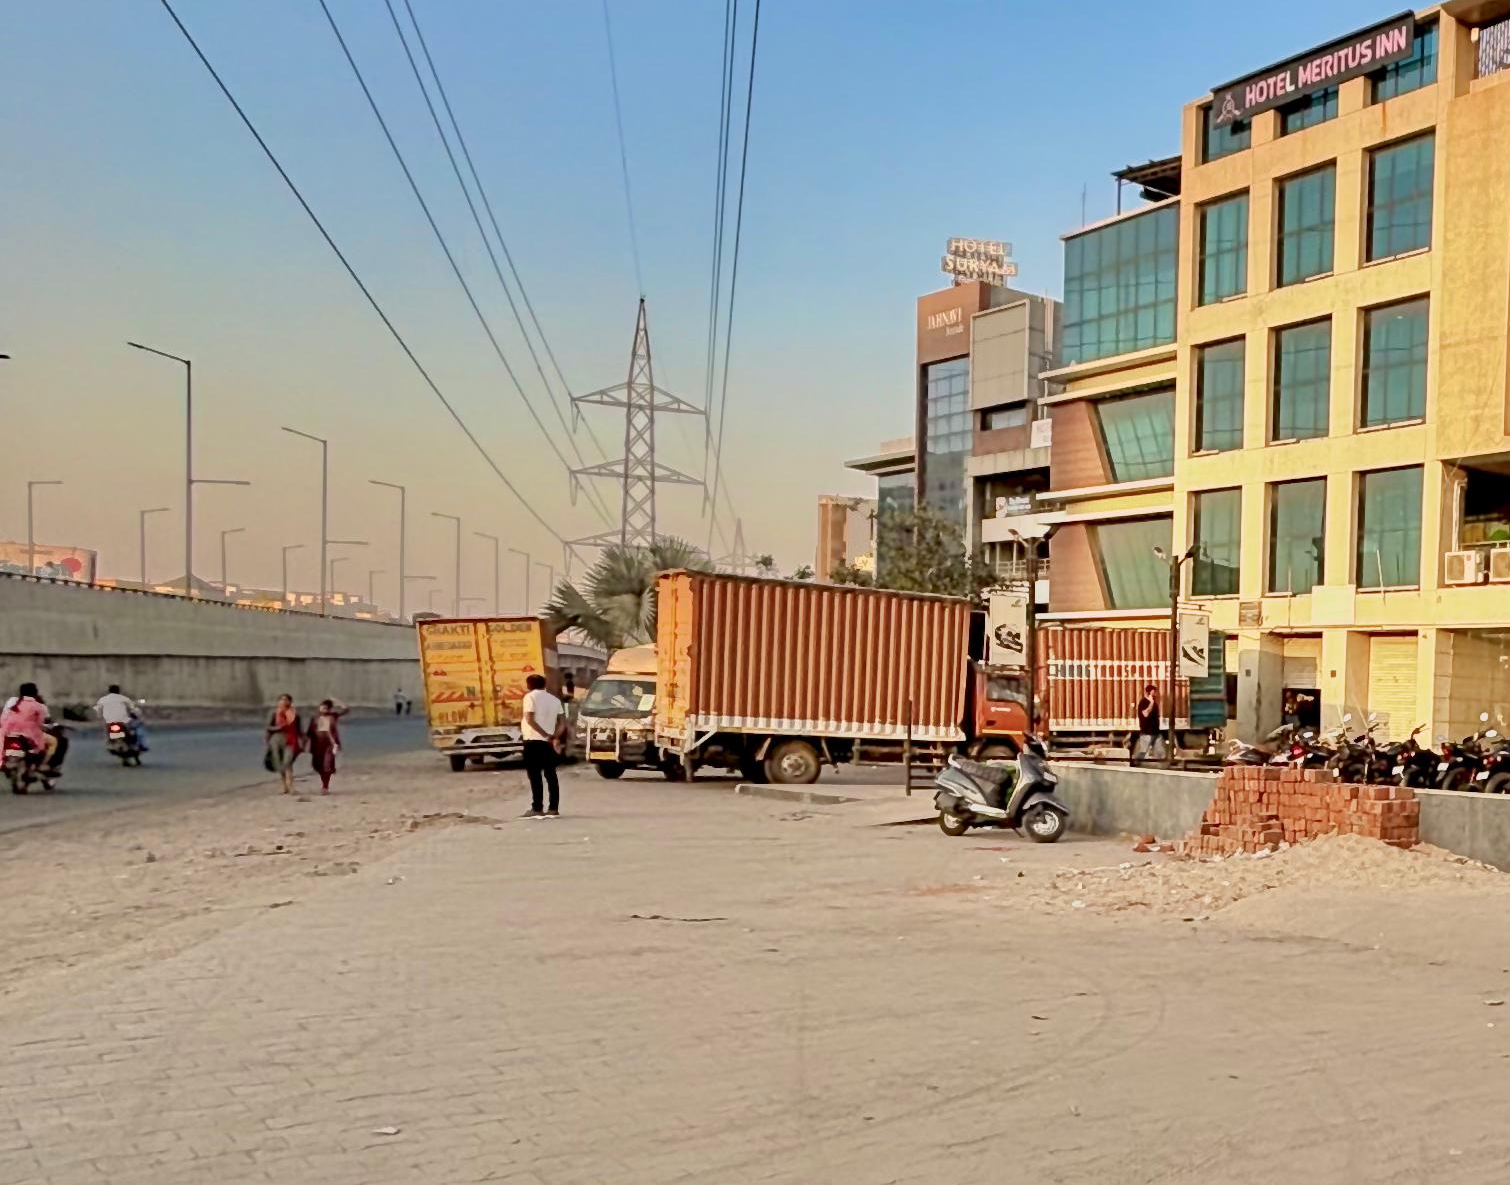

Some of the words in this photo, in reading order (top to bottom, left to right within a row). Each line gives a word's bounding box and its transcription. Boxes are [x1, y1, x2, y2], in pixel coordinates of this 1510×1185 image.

[1245, 69, 1295, 109] HOTEL
[1298, 38, 1373, 88] MERITUS
[1376, 25, 1407, 60] INN
